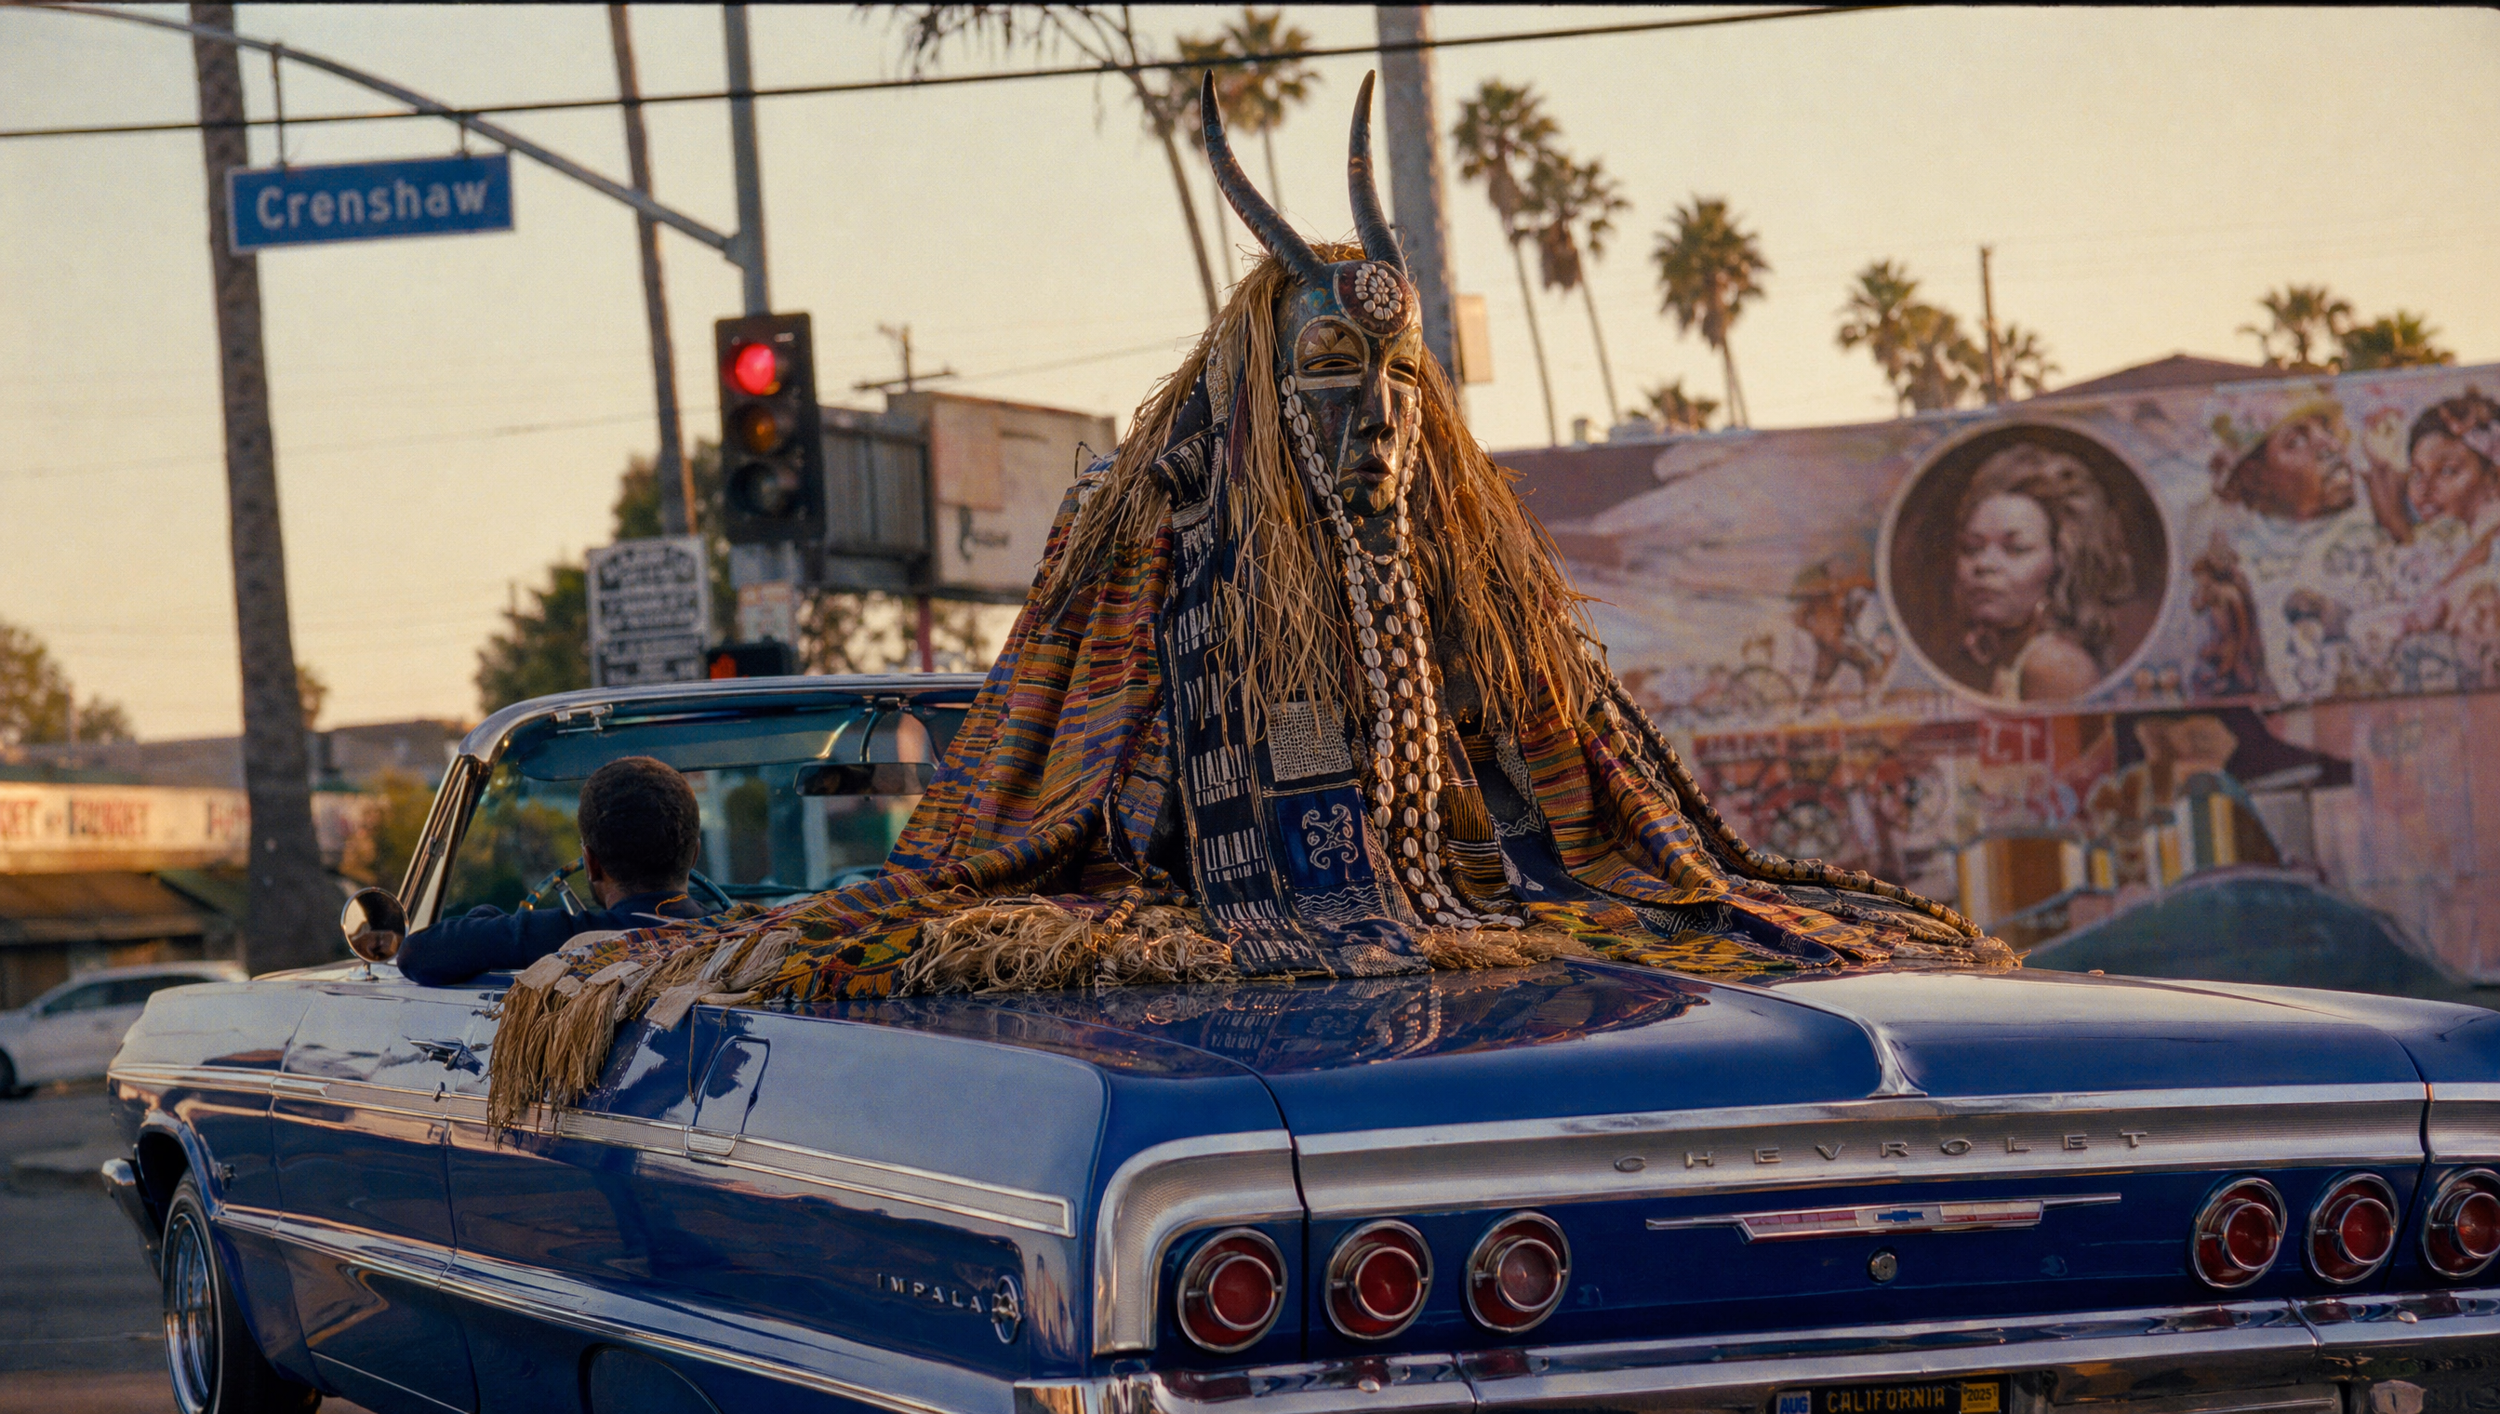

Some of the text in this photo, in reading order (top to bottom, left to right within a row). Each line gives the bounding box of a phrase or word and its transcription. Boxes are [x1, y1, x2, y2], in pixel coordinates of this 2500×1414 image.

[255, 177, 489, 230] Crenshaw
[1613, 1129, 2149, 1173] CHEVROLET
[876, 1272, 985, 1314] IMPALA
[1779, 1396, 1809, 1414] AUG
[1826, 1387, 1946, 1413] CALIFORNIA
[1967, 1387, 1993, 1402] 2025
